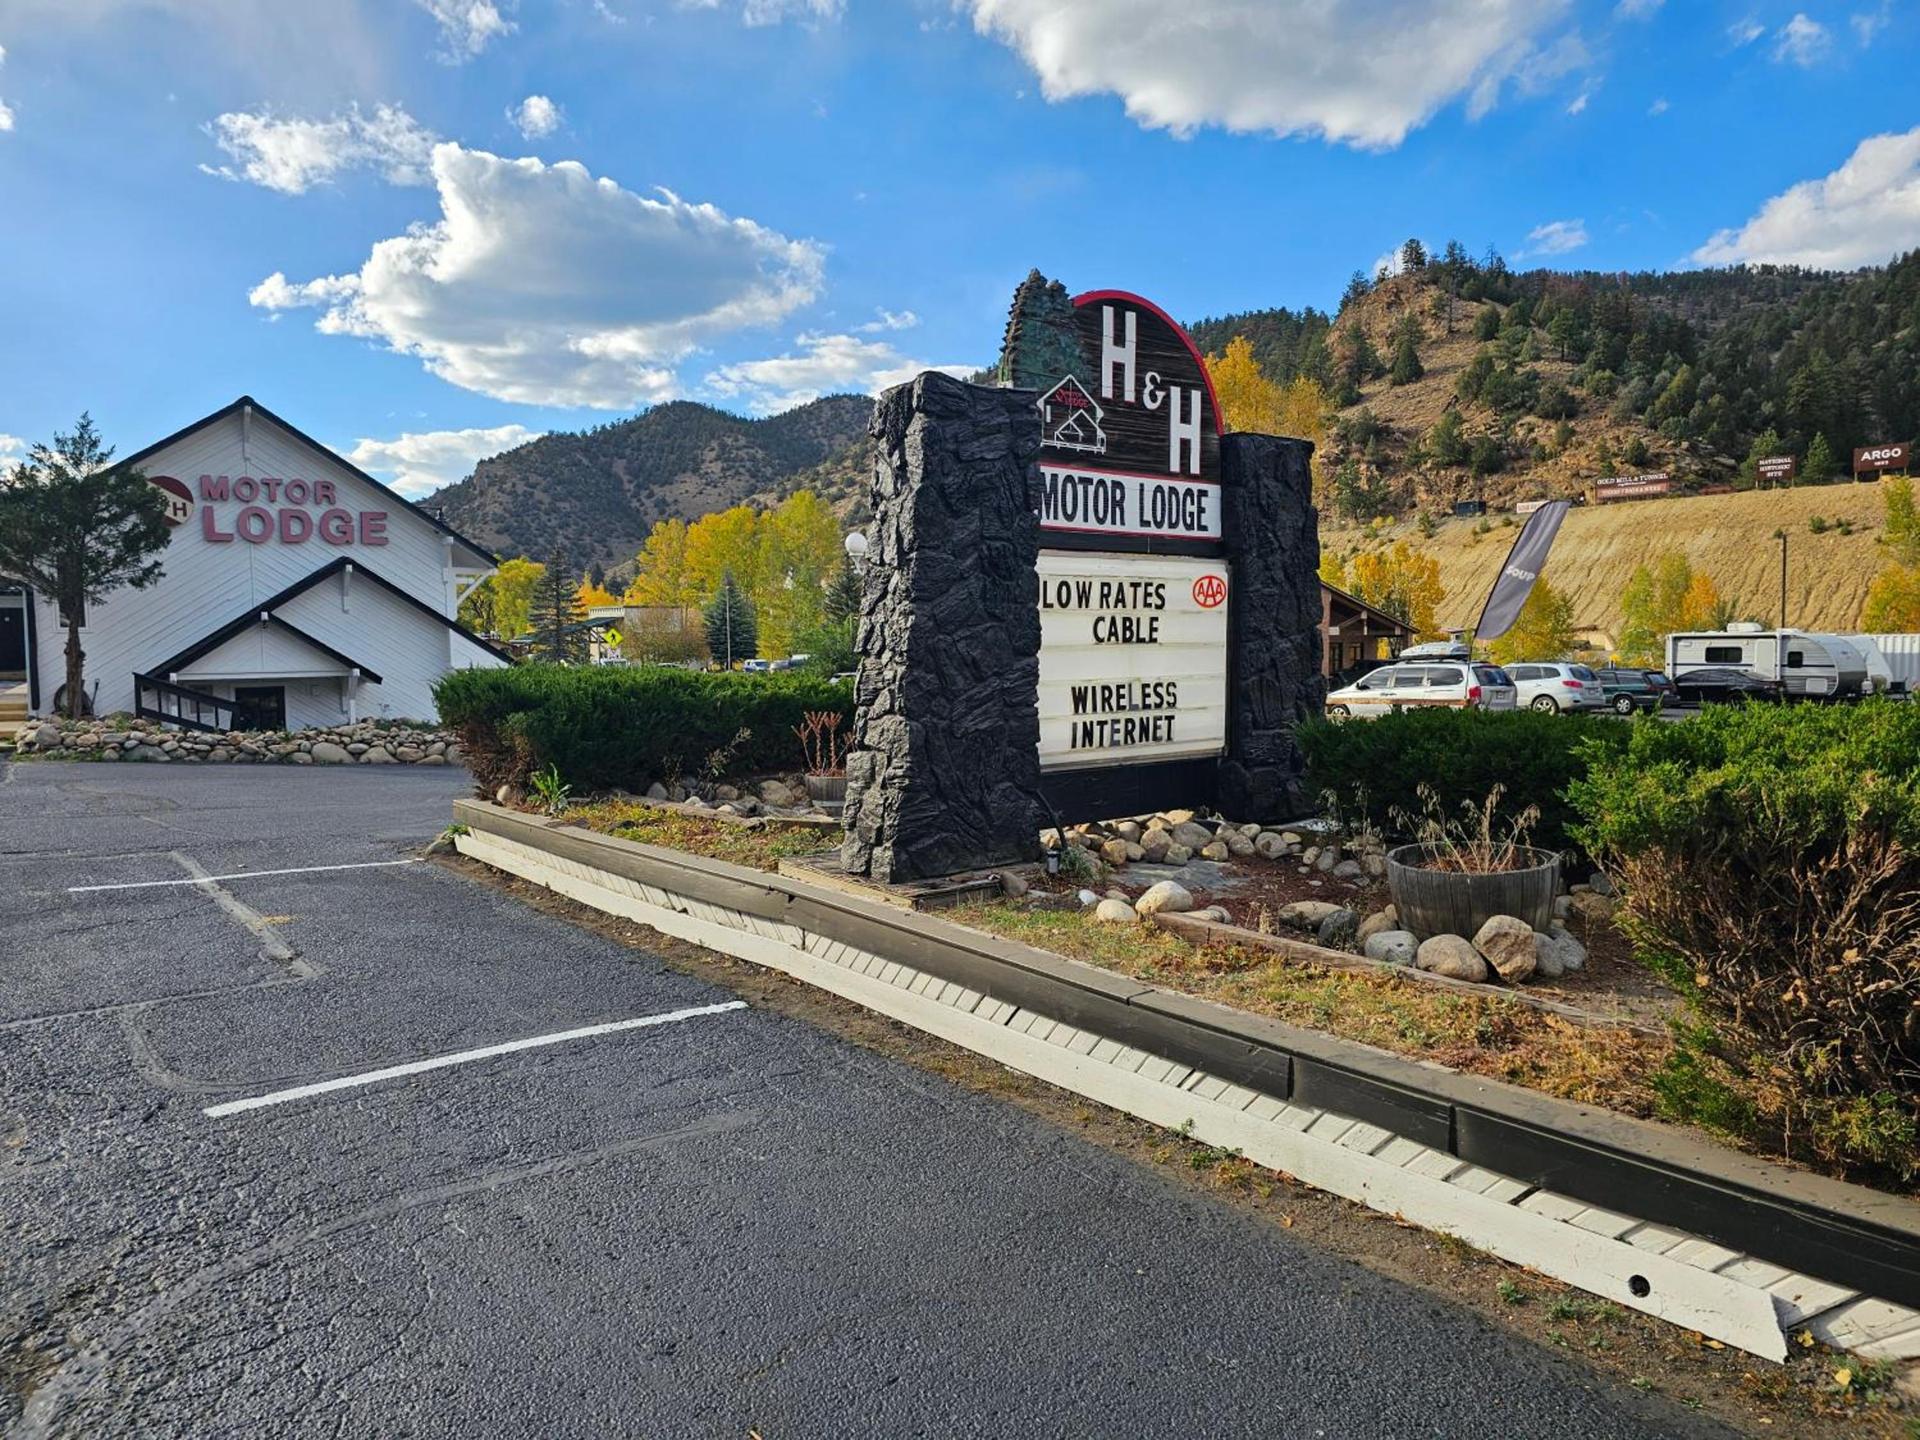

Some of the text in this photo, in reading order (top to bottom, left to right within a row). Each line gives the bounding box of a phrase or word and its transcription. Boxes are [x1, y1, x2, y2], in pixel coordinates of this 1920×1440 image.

[1101, 305, 1201, 475] H & H
[1860, 447, 1902, 461] ARGO
[200, 475, 336, 505] MOTOR
[1040, 471, 1209, 532] MOTOR LODGE
[202, 505, 389, 546] LODGE
[1505, 565, 1536, 581] SOUP
[1042, 580, 1166, 611] LOW RATES
[1196, 576, 1224, 606] AAA
[1093, 616, 1159, 643] CABLE
[1071, 682, 1177, 715] WIRELESS
[1071, 715, 1176, 749] INTERNET
